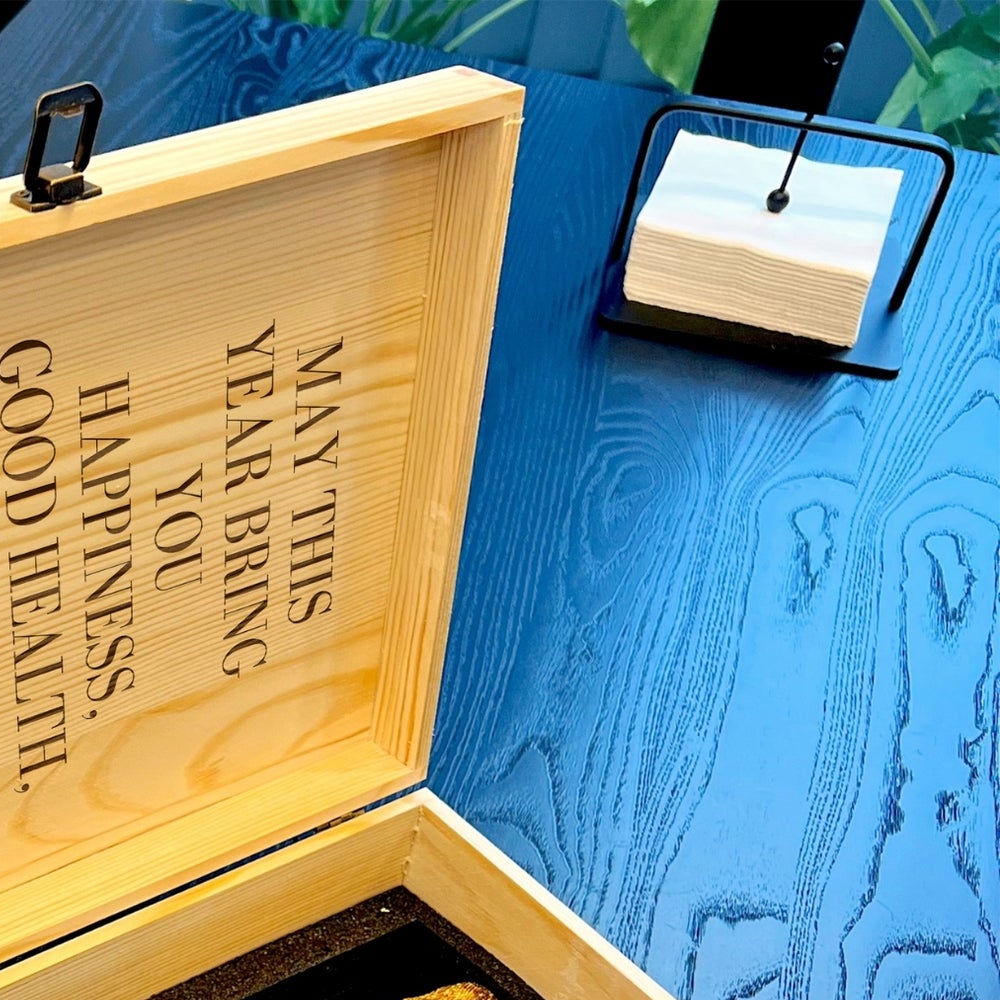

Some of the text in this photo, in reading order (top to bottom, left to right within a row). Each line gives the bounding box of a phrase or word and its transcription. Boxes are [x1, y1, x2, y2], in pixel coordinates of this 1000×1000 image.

[78, 371, 135, 721] HAPPINESS,
[154, 463, 203, 592] YOU
[221, 318, 275, 679] YEAR BRING
[288, 336, 344, 625] MAY THIS
[8, 536, 67, 794] HEALTH,
